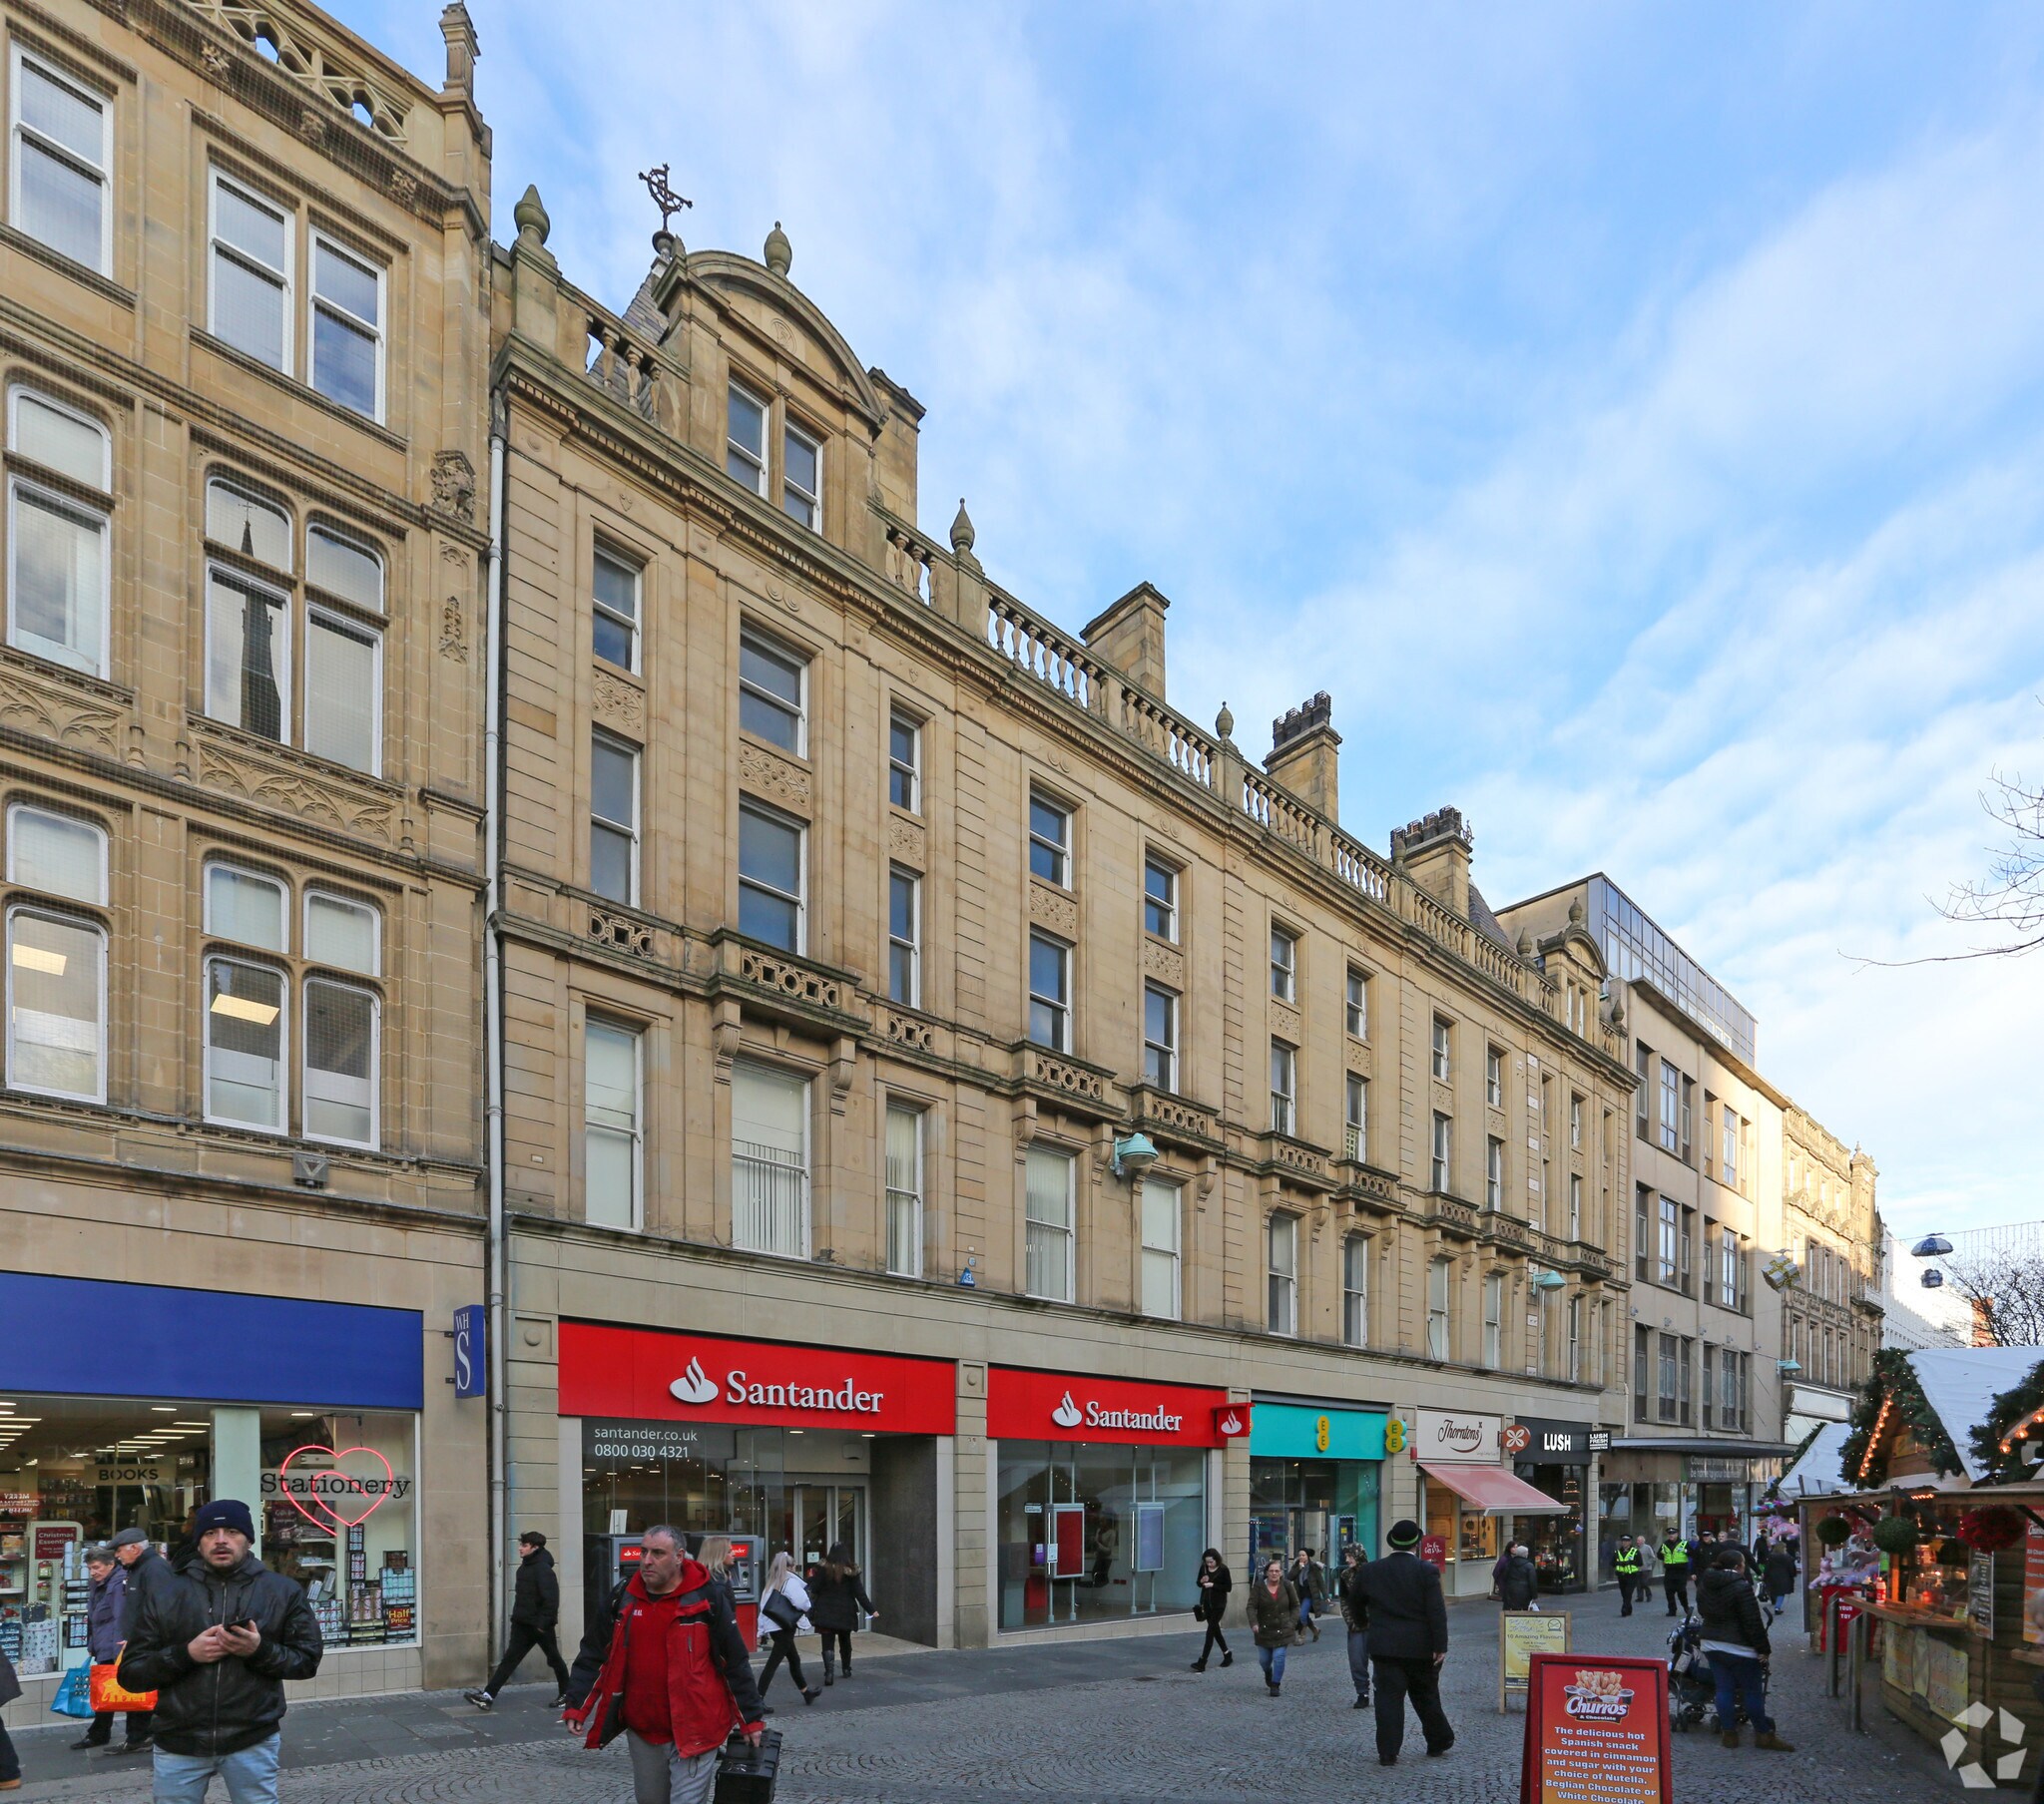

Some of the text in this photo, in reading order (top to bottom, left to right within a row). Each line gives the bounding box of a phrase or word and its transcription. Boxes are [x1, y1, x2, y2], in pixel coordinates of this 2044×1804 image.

[455, 1313, 469, 1331] WH
[456, 1330, 470, 1390] S
[726, 1370, 883, 1412] Santander
[1086, 1401, 1182, 1431] Santander
[595, 1428, 698, 1442] santander.co.uk
[1438, 1419, 1481, 1443] Thorntons
[1544, 1433, 1571, 1452] LUSH
[595, 1444, 689, 1458] 0800 030 4321
[99, 1469, 159, 1481] BOOKS
[260, 1473, 411, 1499] Stationery
[388, 1609, 410, 1618] Half
[1566, 1695, 1628, 1715] Churros
[1555, 1726, 1573, 1735] The
[1576, 1728, 1625, 1739] delicious
[1561, 1737, 1639, 1750] Spanish snack
[1545, 1748, 1588, 1758] covered
[1603, 1752, 1657, 1763] cinnamon
[1569, 1759, 1600, 1769] sugar
[1629, 1765, 1655, 1774] your
[1554, 1770, 1589, 1779] choice
[1605, 1773, 1648, 1784] Nutella.
[1545, 1779, 1585, 1790] Beglian
[1588, 1782, 1642, 1795] Chocolate
[1557, 1791, 1645, 1804] White Chocolate
